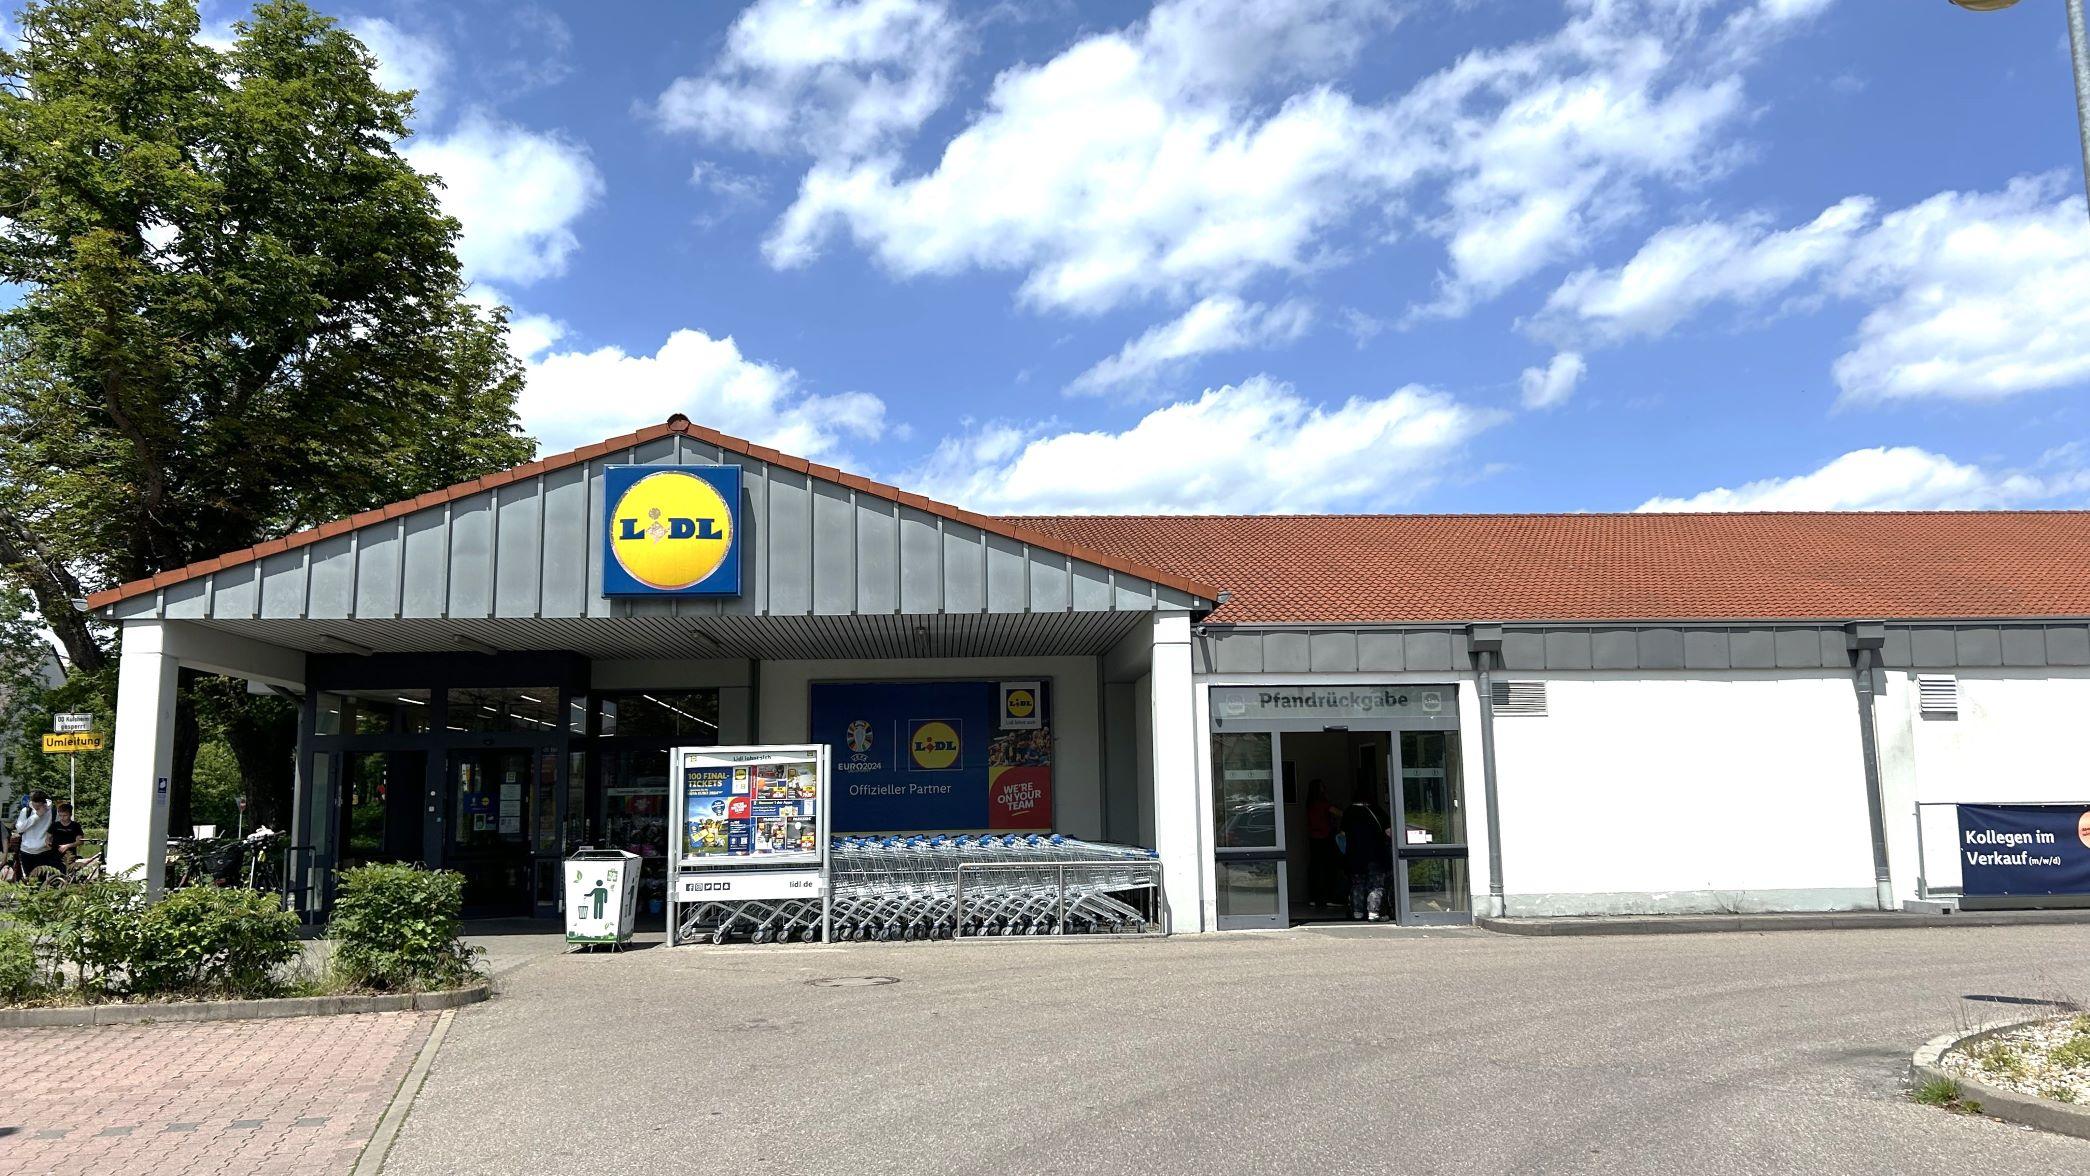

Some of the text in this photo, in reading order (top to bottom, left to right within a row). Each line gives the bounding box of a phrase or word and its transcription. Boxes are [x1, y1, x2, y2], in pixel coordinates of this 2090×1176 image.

[619, 508, 723, 544] LIDL
[1008, 698, 1033, 708] LIDL
[1258, 690, 1409, 712] Pfandrückgabe
[46, 737, 101, 747] Umleitung
[914, 736, 957, 753] LIDL
[837, 763, 882, 771] EURO2024
[703, 772, 730, 780] FINAL-
[687, 780, 723, 788] TICKETS
[849, 783, 952, 796] Offizieller Partner
[1003, 782, 1034, 795] WE'RE
[997, 789, 1042, 804] ON YOUR
[1007, 799, 1034, 811] TEAM
[1965, 829, 2055, 848] Kollegen im
[1966, 851, 2062, 866] Verkauf (m/w/d)
[789, 880, 813, 888] lidlde
